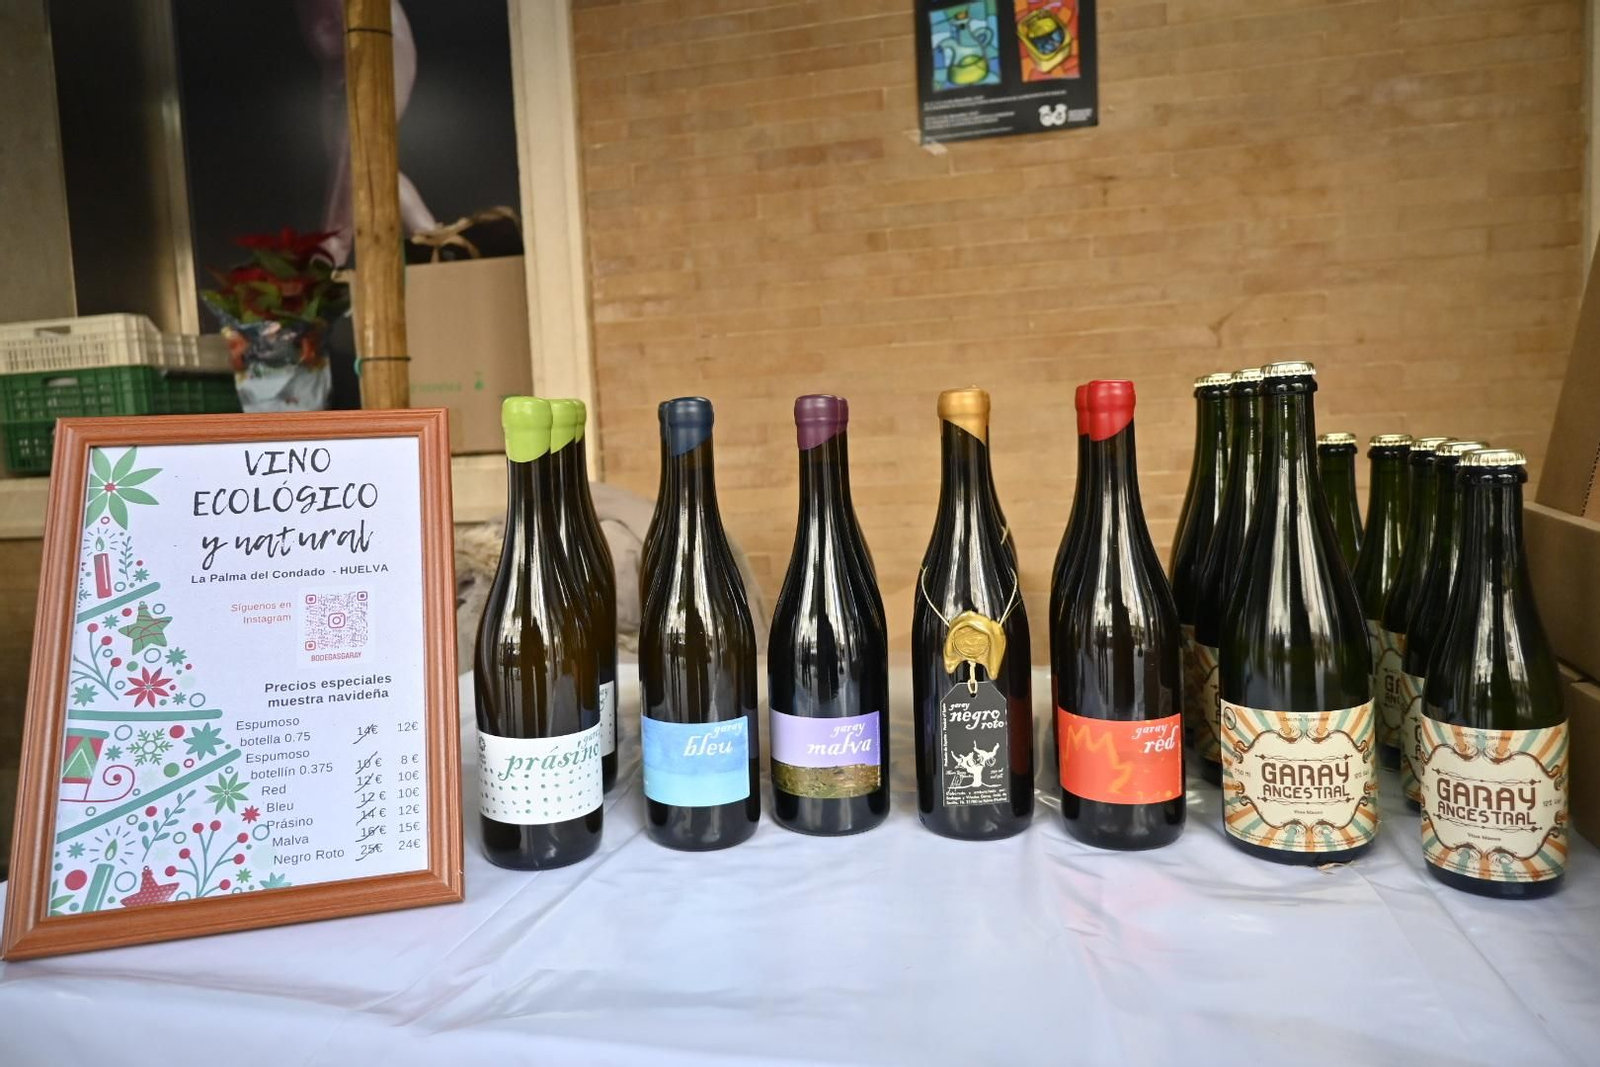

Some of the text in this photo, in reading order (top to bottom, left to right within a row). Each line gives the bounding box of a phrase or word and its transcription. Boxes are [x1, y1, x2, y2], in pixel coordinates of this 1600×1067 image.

[245, 447, 331, 476] VINO
[193, 480, 378, 516] ECOLÓGICO
[202, 519, 374, 570] y natural
[191, 575, 206, 584] La
[210, 572, 247, 583] Palma
[250, 571, 269, 580] del
[272, 568, 325, 579] Condado
[340, 564, 389, 575] HUELVA
[231, 601, 292, 613] Síguenos en
[243, 613, 291, 625] Instagram
[311, 651, 362, 662] BODEGASGARAY
[265, 674, 392, 693] Precios especiales
[268, 688, 389, 708] muestra navideña
[949, 703, 970, 711] garay
[236, 717, 300, 732] Espumoso
[710, 722, 743, 738] garay
[830, 722, 865, 738] garay
[949, 710, 1000, 730] negro
[981, 719, 1004, 729] roto
[1131, 724, 1168, 739] garay
[240, 735, 281, 747] botella
[284, 732, 311, 743] 0.75
[397, 721, 419, 732] 12€
[683, 733, 733, 756] bleu
[806, 732, 872, 755] malva
[1143, 725, 1179, 753] red
[246, 749, 310, 765] Espumoso
[251, 766, 296, 780] botellín
[299, 763, 333, 775] 0.375
[401, 755, 408, 765] 8
[498, 740, 599, 781] prásino
[261, 784, 286, 796] Red
[398, 770, 420, 782] 10€
[1261, 762, 1349, 786] GARAY
[266, 801, 294, 813] Bleu
[398, 787, 420, 799] 10€
[1263, 785, 1350, 799] ANCESTRAL
[1437, 778, 1536, 811] GARAY
[266, 815, 314, 830] Prásino
[398, 804, 420, 816] 12€
[1438, 801, 1536, 826] ANCESTRAL
[272, 834, 309, 847] Malva
[399, 822, 420, 833] 15€
[273, 852, 311, 866] Negro
[316, 848, 345, 860] Roto
[399, 839, 421, 850] 24€
